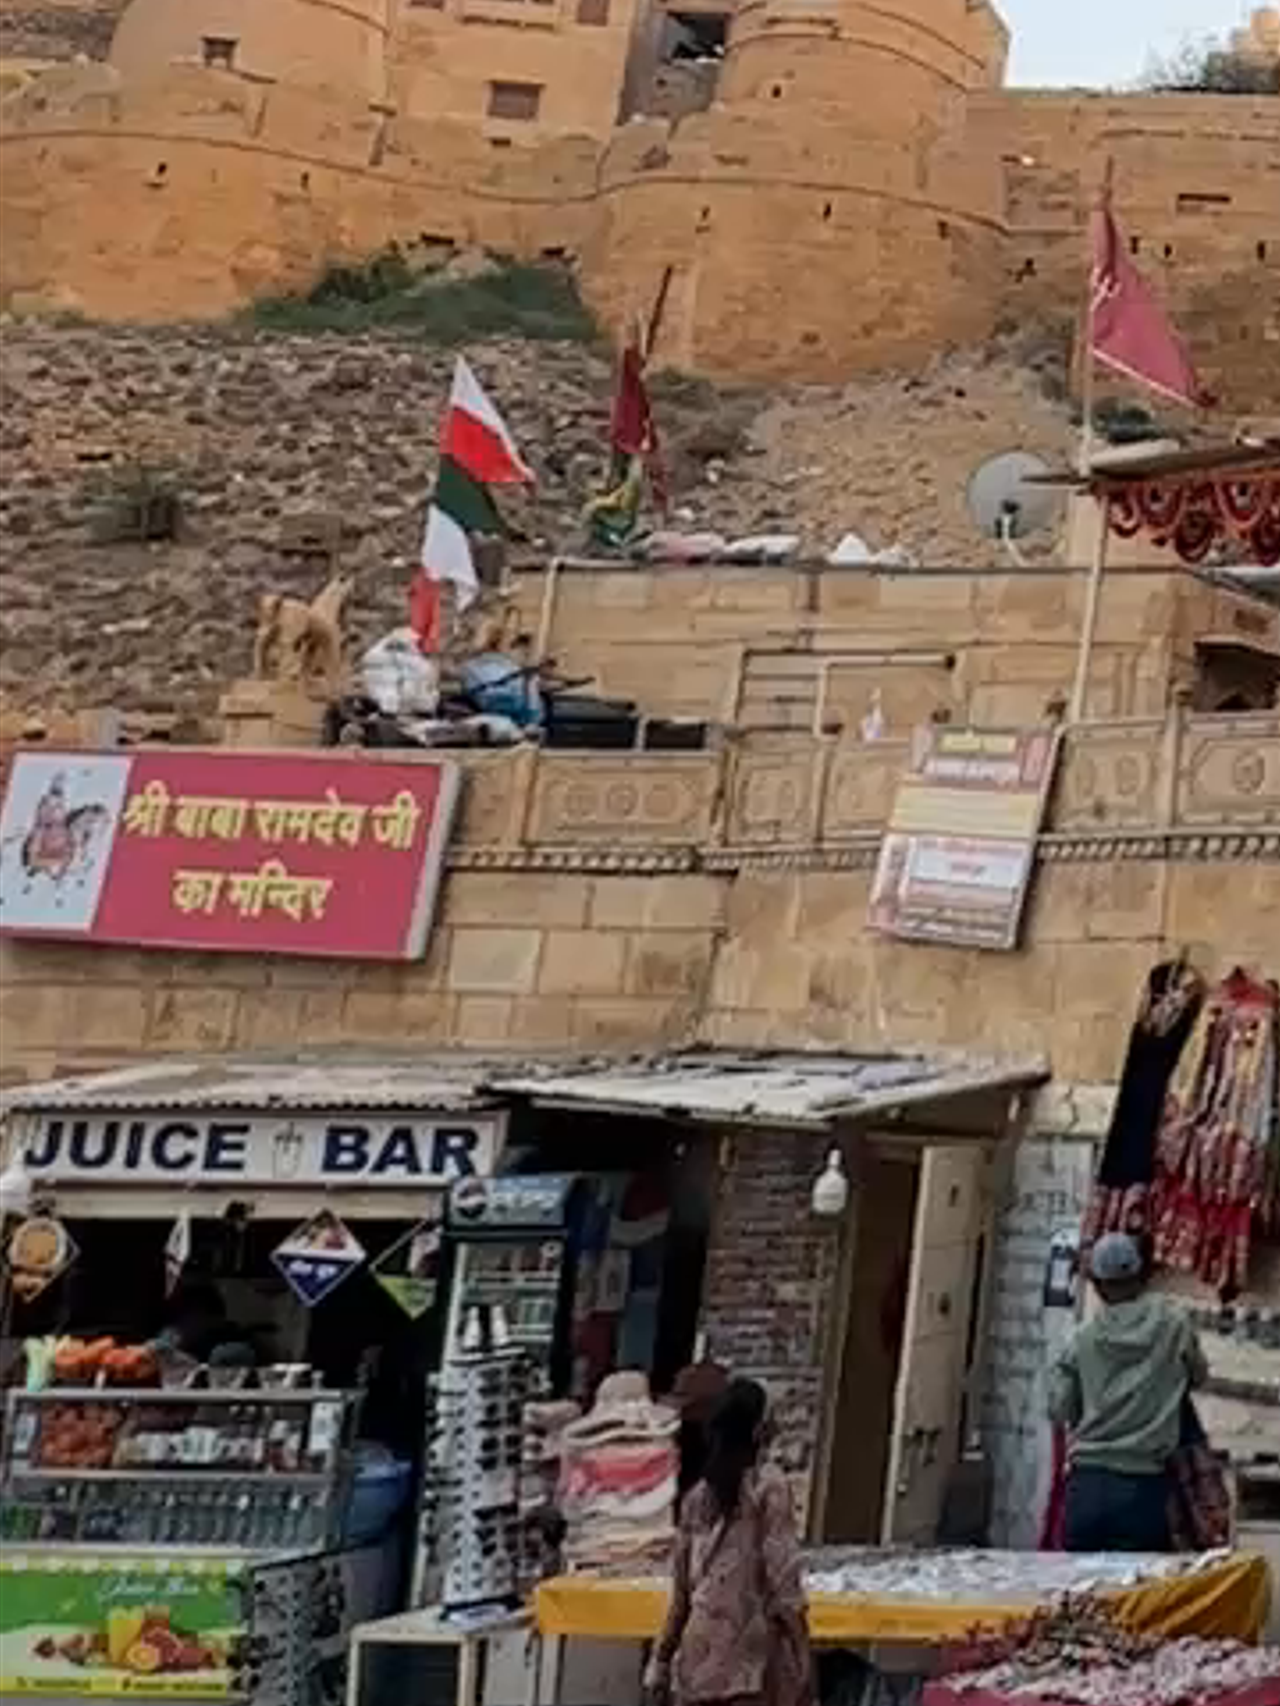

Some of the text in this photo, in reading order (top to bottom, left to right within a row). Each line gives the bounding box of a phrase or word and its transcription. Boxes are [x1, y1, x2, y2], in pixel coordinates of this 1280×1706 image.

[124, 780, 422, 849] श्री बाबा रामदेव जी
[172, 859, 334, 921] का मन्दिर
[24, 1120, 480, 1176] JUICE BAR
